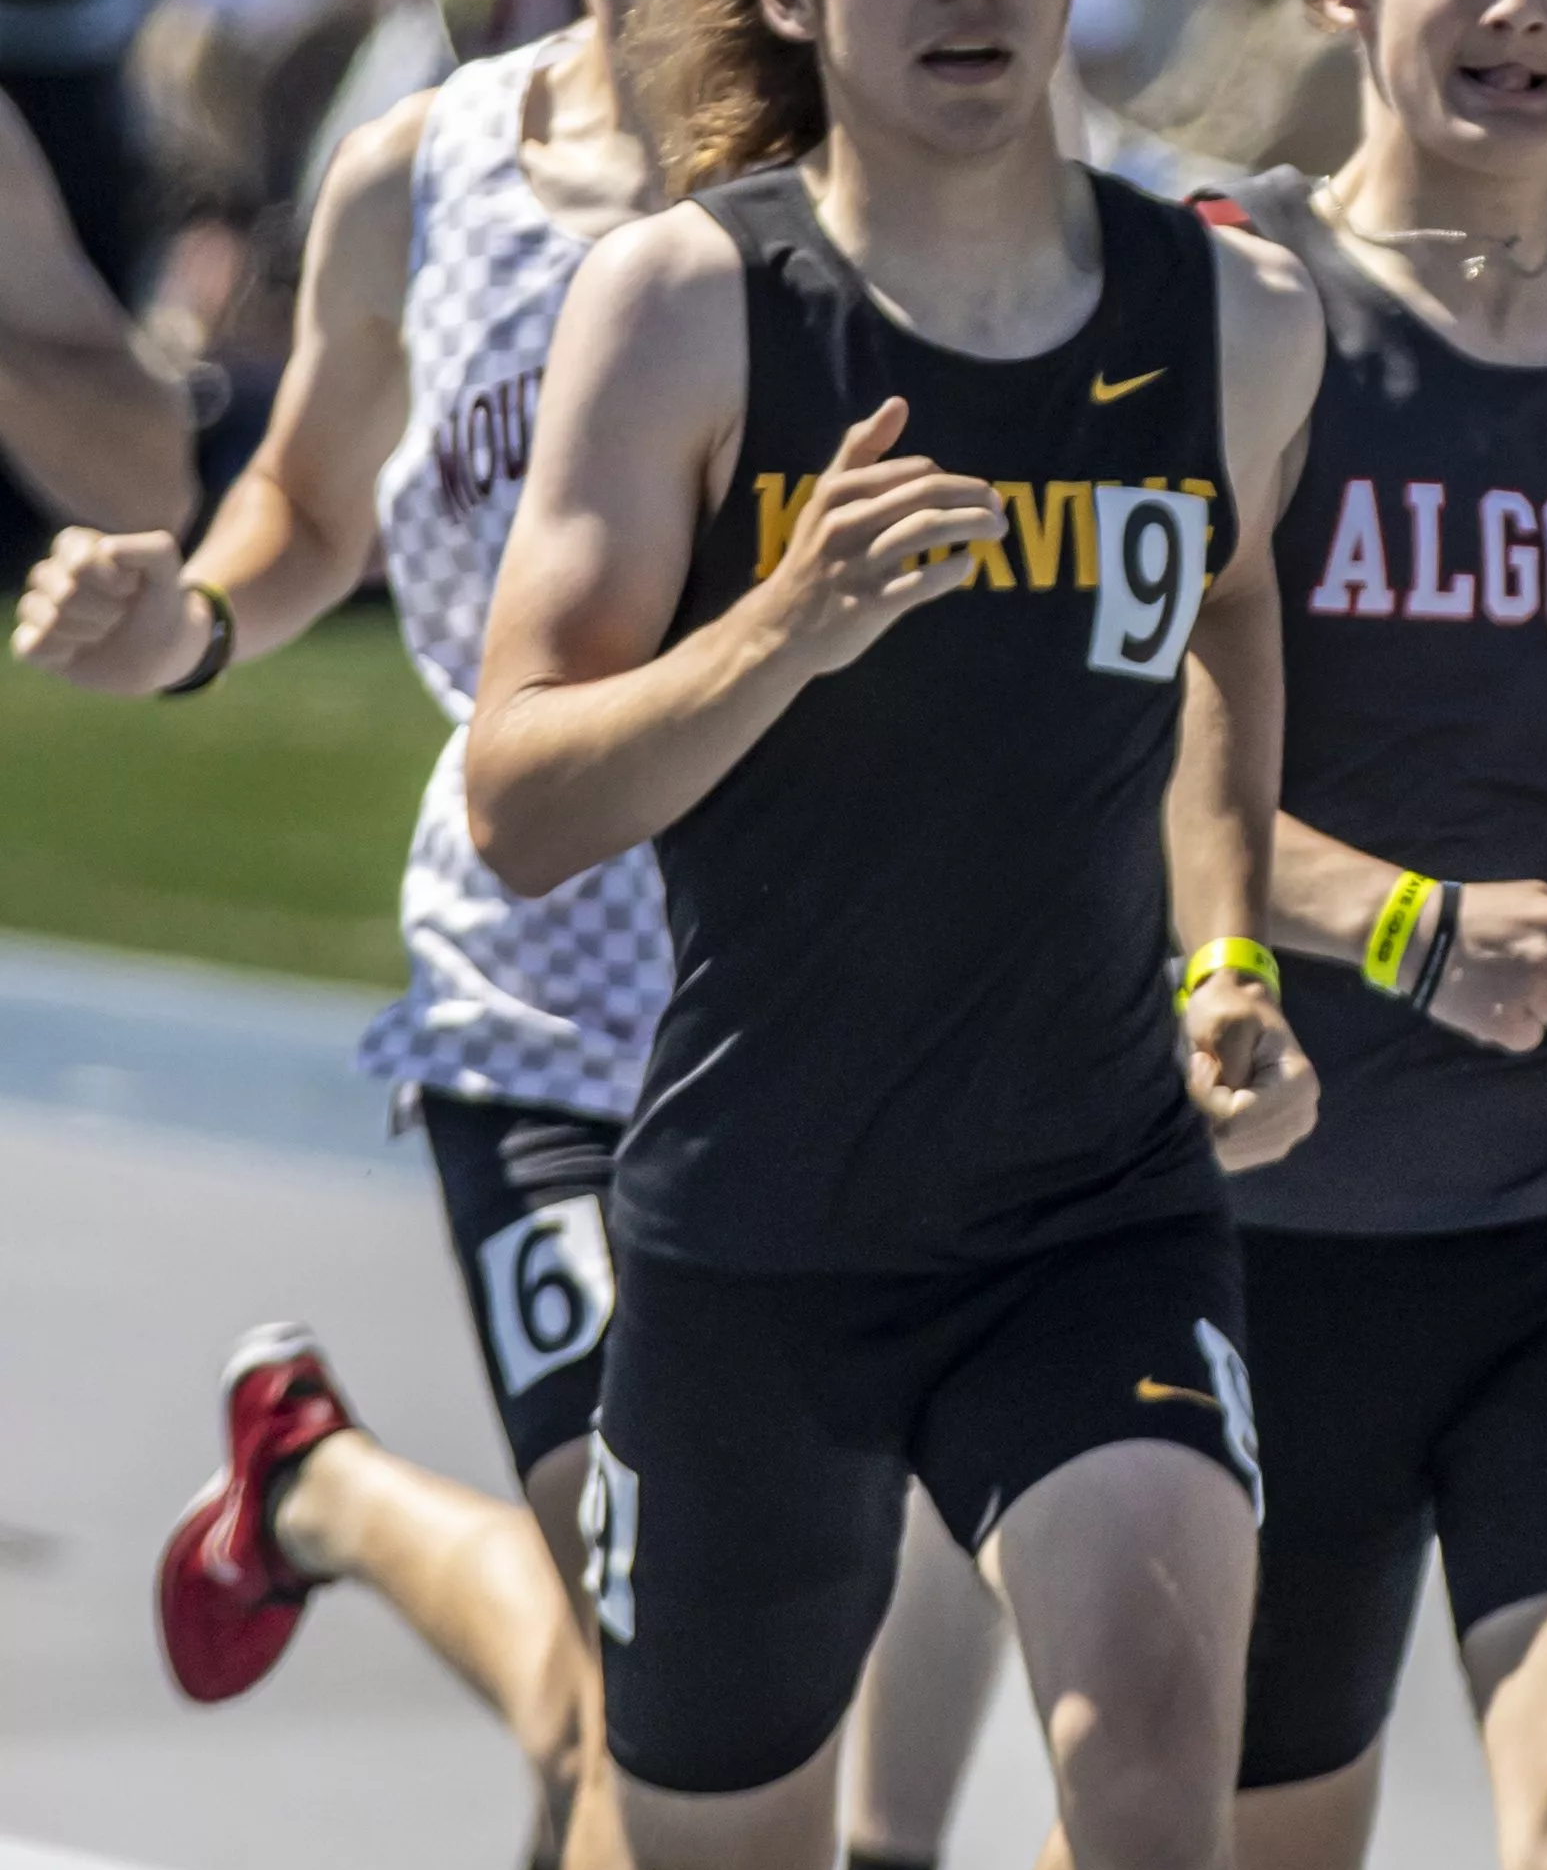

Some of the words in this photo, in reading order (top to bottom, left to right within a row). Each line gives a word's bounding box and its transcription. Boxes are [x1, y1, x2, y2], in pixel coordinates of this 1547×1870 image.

[433, 365, 544, 525] MOU
[1121, 497, 1184, 665] 9
[515, 1219, 587, 1355] 6
